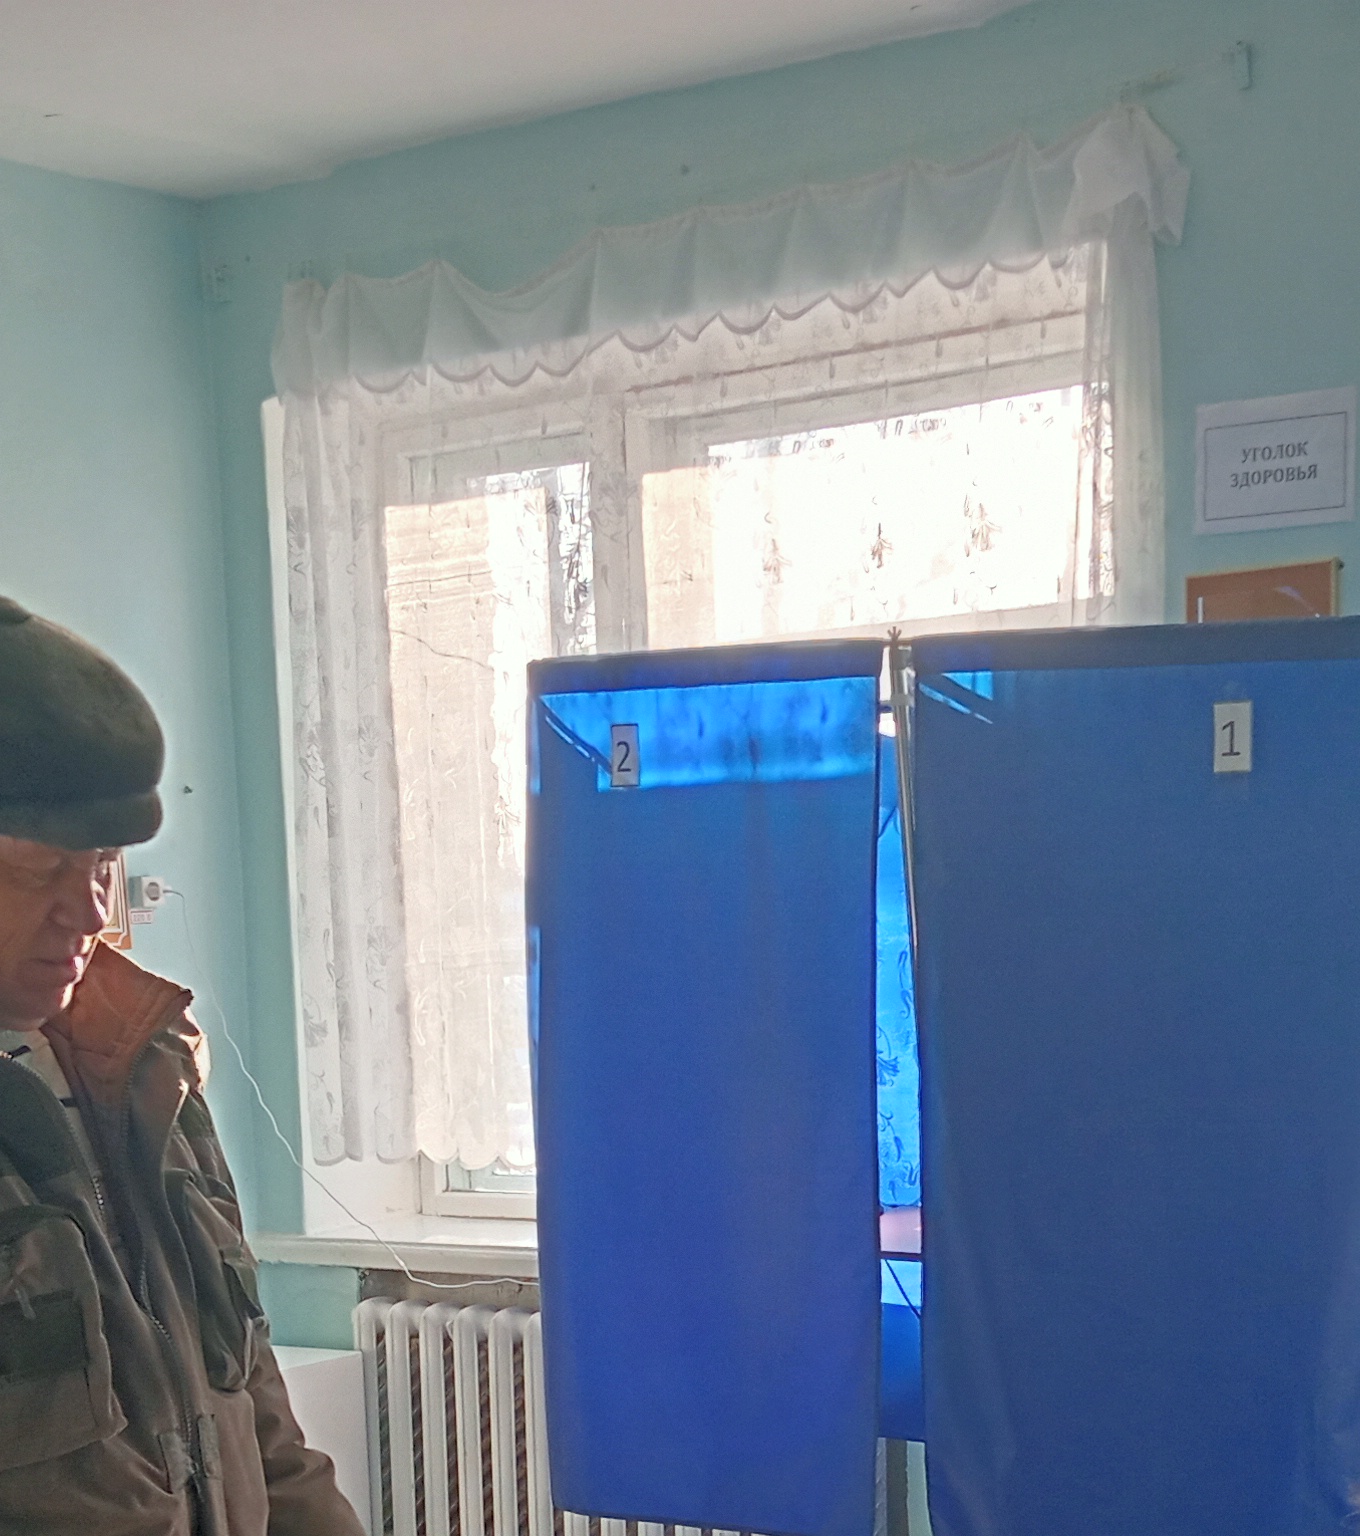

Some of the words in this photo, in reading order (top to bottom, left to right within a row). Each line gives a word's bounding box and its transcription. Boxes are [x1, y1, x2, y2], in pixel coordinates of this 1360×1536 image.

[1241, 441, 1309, 463] УГОЛОК
[1230, 464, 1318, 489] ЗДОРОВЬЯ
[1221, 721, 1240, 756] 1
[616, 741, 632, 772] 2
